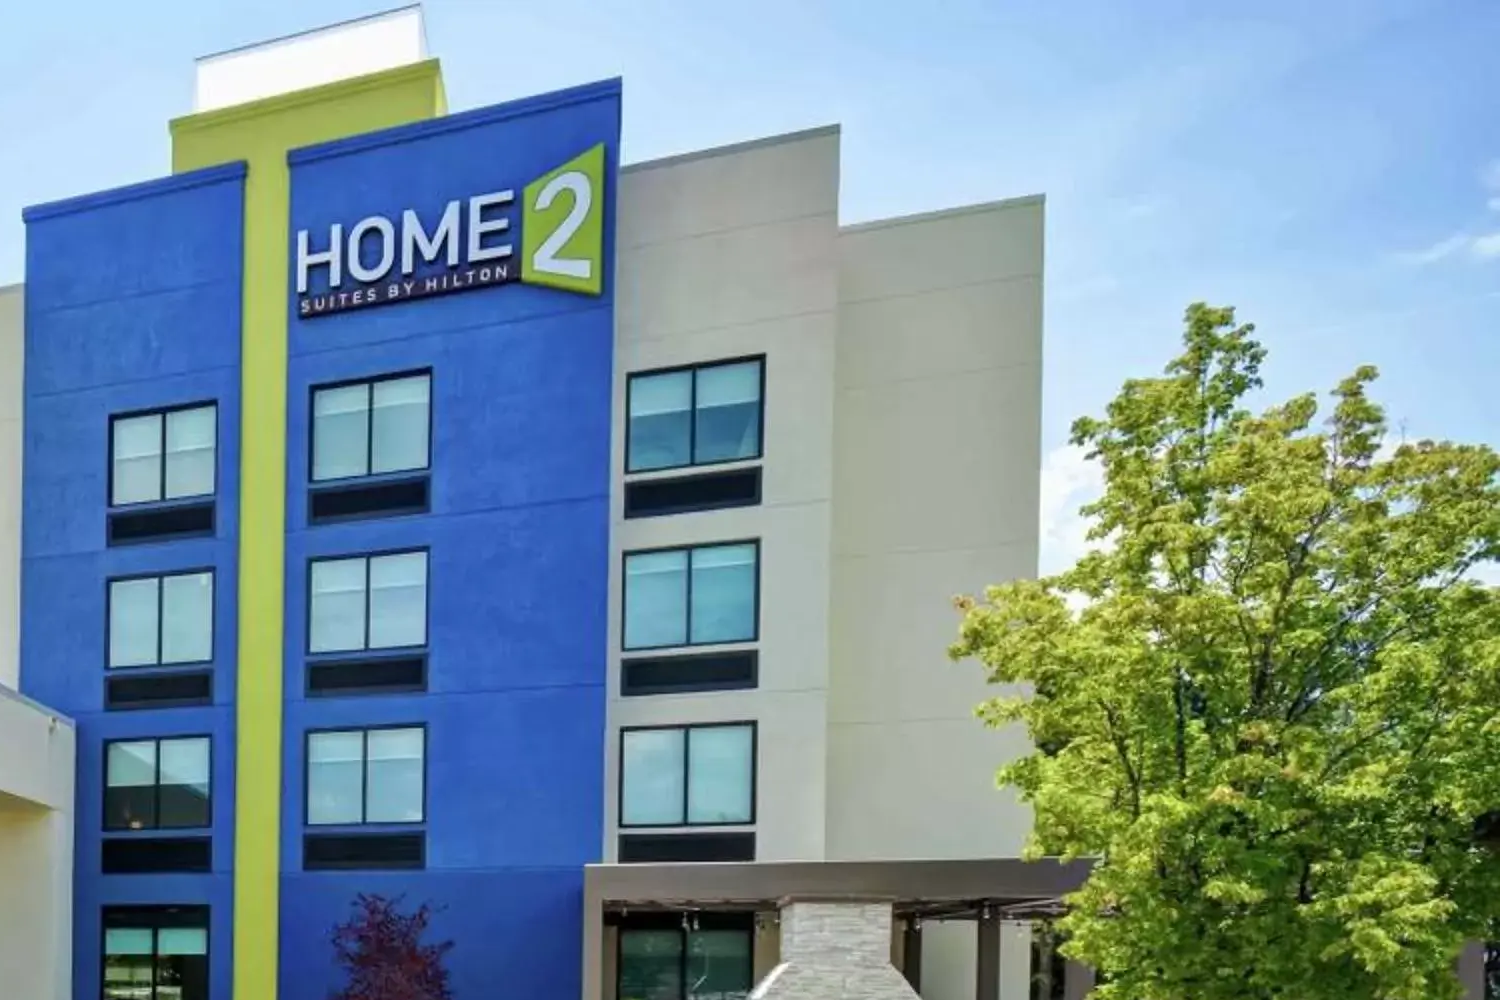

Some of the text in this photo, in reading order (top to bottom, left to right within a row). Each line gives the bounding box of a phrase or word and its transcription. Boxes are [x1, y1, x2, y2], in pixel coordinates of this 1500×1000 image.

[297, 170, 592, 293] HOME 2
[301, 264, 508, 314] SUITES BY HILTON
